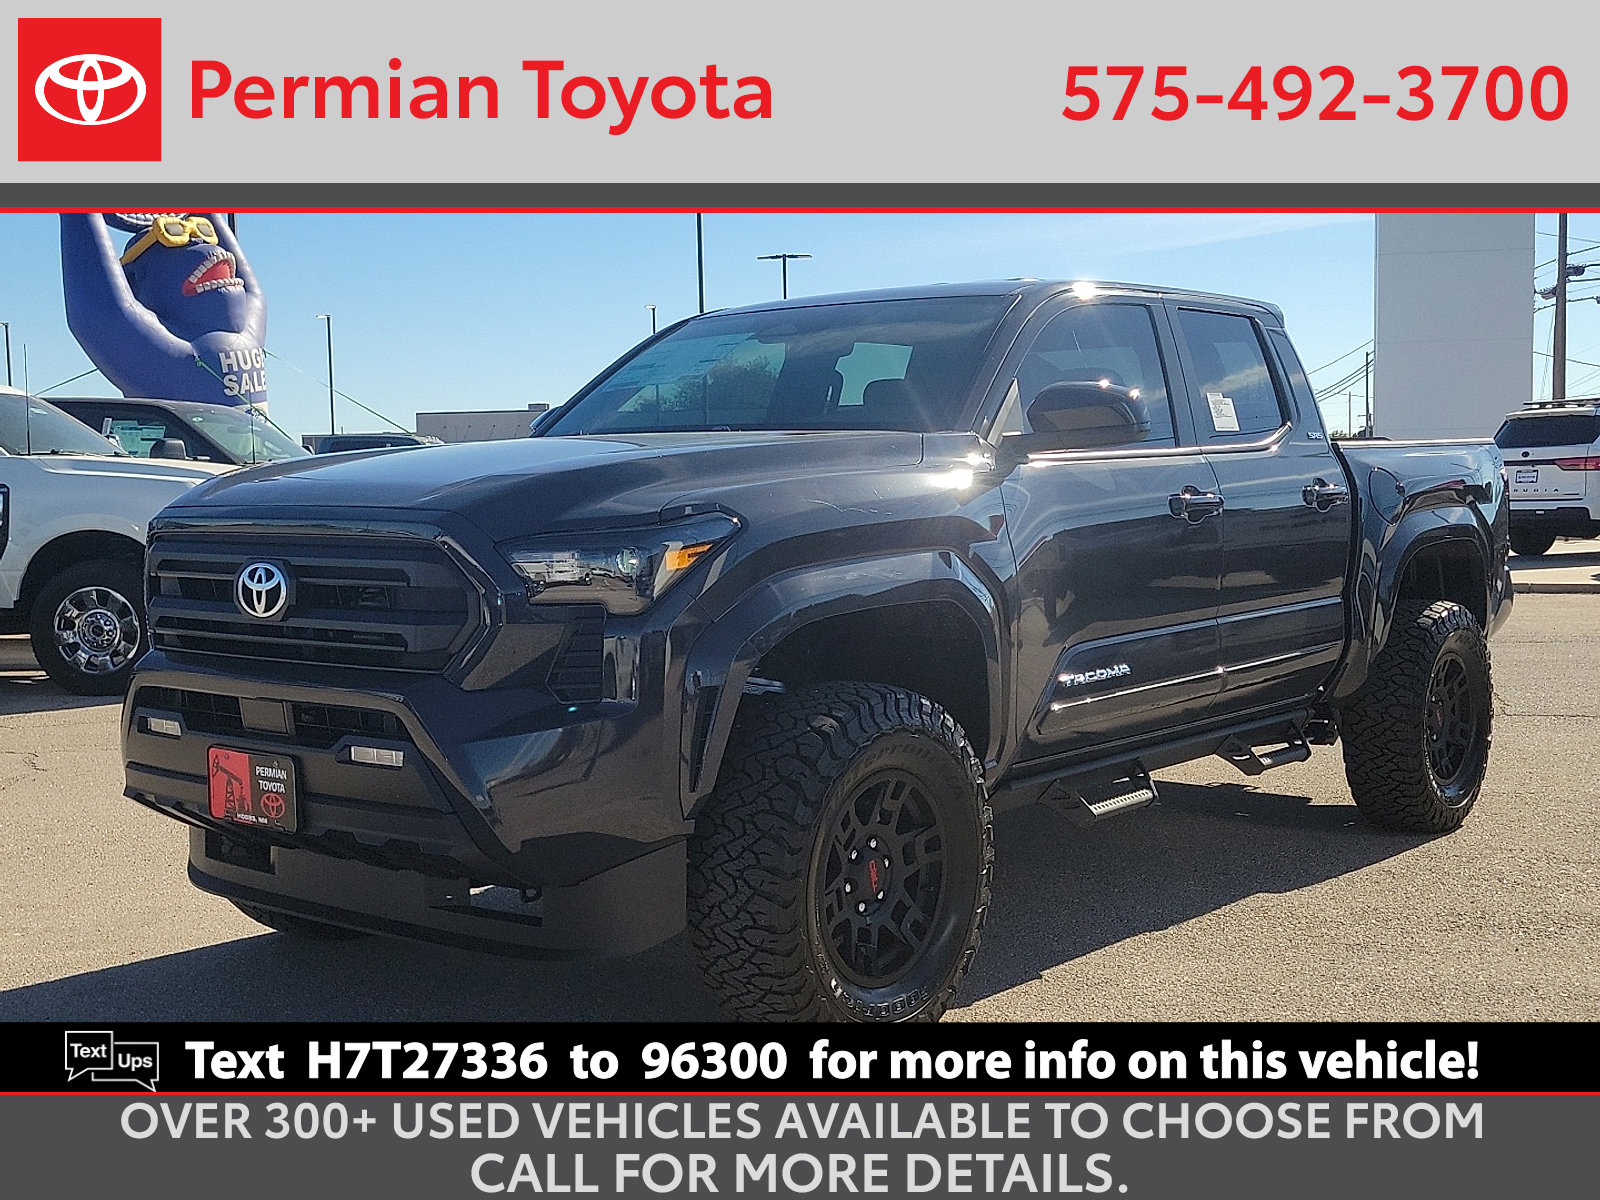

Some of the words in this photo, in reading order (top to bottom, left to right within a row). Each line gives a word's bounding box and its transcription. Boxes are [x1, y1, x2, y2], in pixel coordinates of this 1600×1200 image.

[223, 371, 267, 396] SALE
[1059, 663, 1132, 687] TACOMA
[255, 765, 287, 780] PERMIAN
[258, 780, 286, 794] TOYOTA
